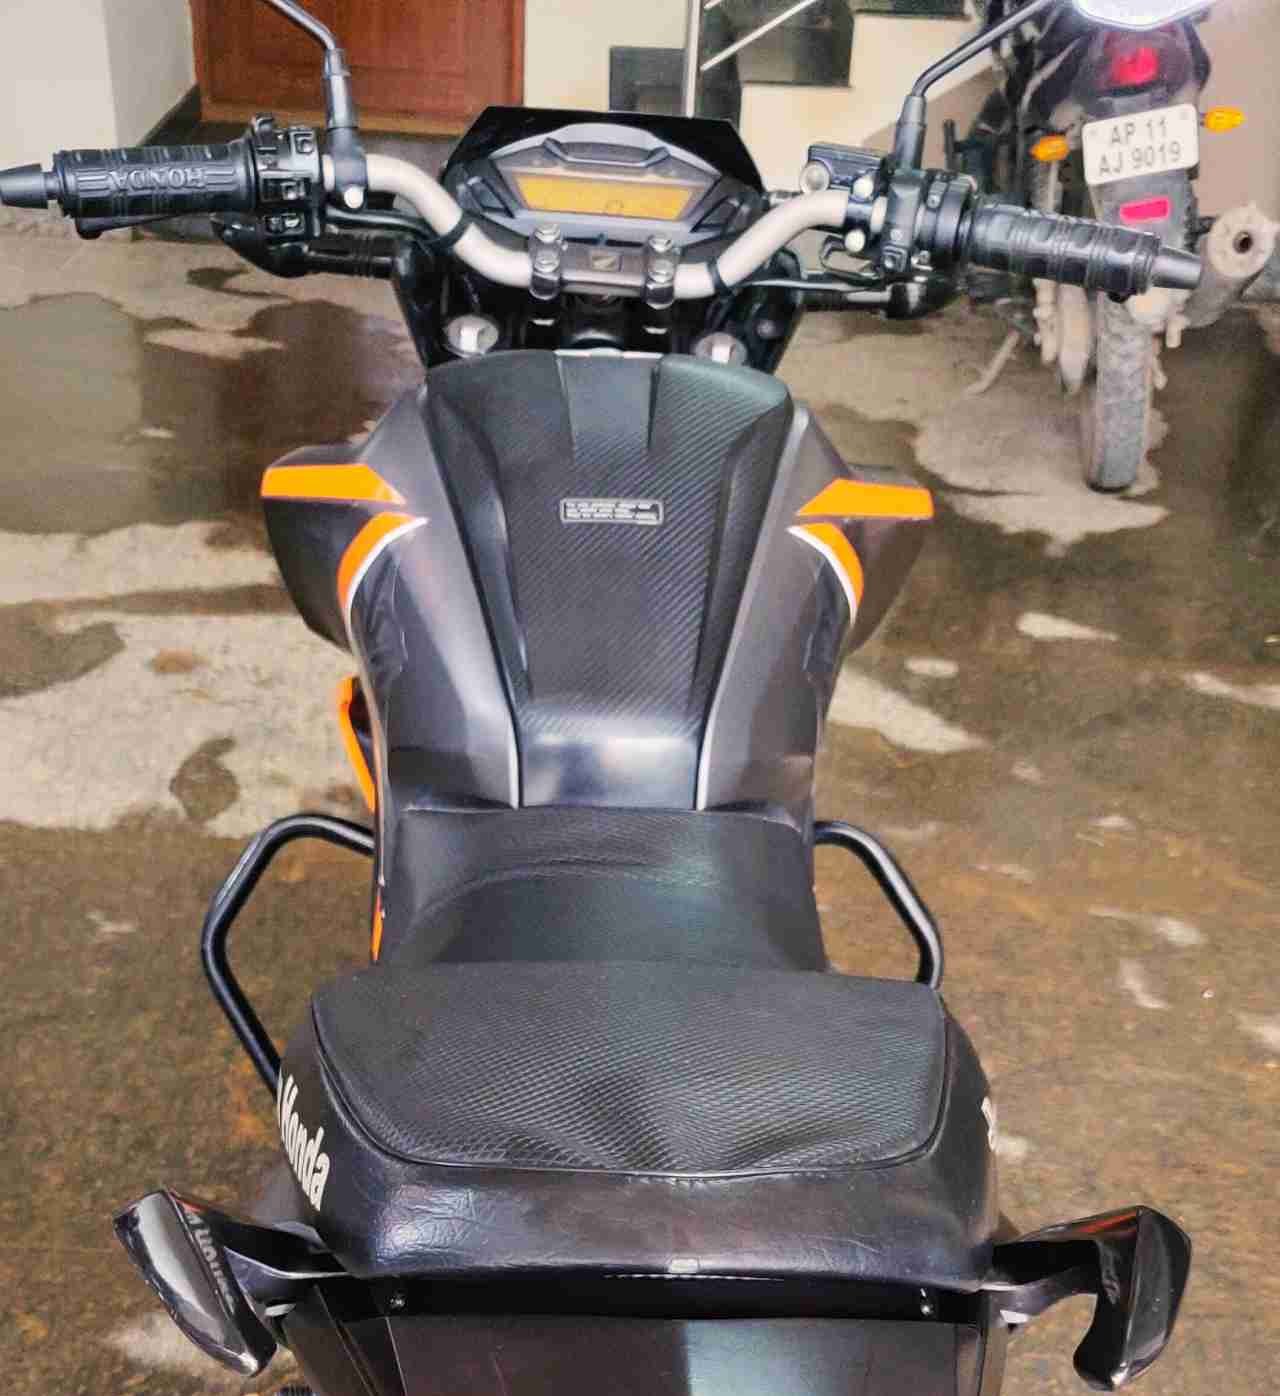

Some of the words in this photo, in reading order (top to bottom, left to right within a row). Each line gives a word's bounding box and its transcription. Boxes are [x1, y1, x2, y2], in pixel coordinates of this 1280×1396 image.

[1110, 121, 1136, 147] AP
[1146, 116, 1166, 141] 11
[1099, 153, 1123, 175] AJ
[1131, 140, 1181, 169] 9019
[108, 167, 208, 191] HONDA
[281, 1072, 331, 1212] Honda
